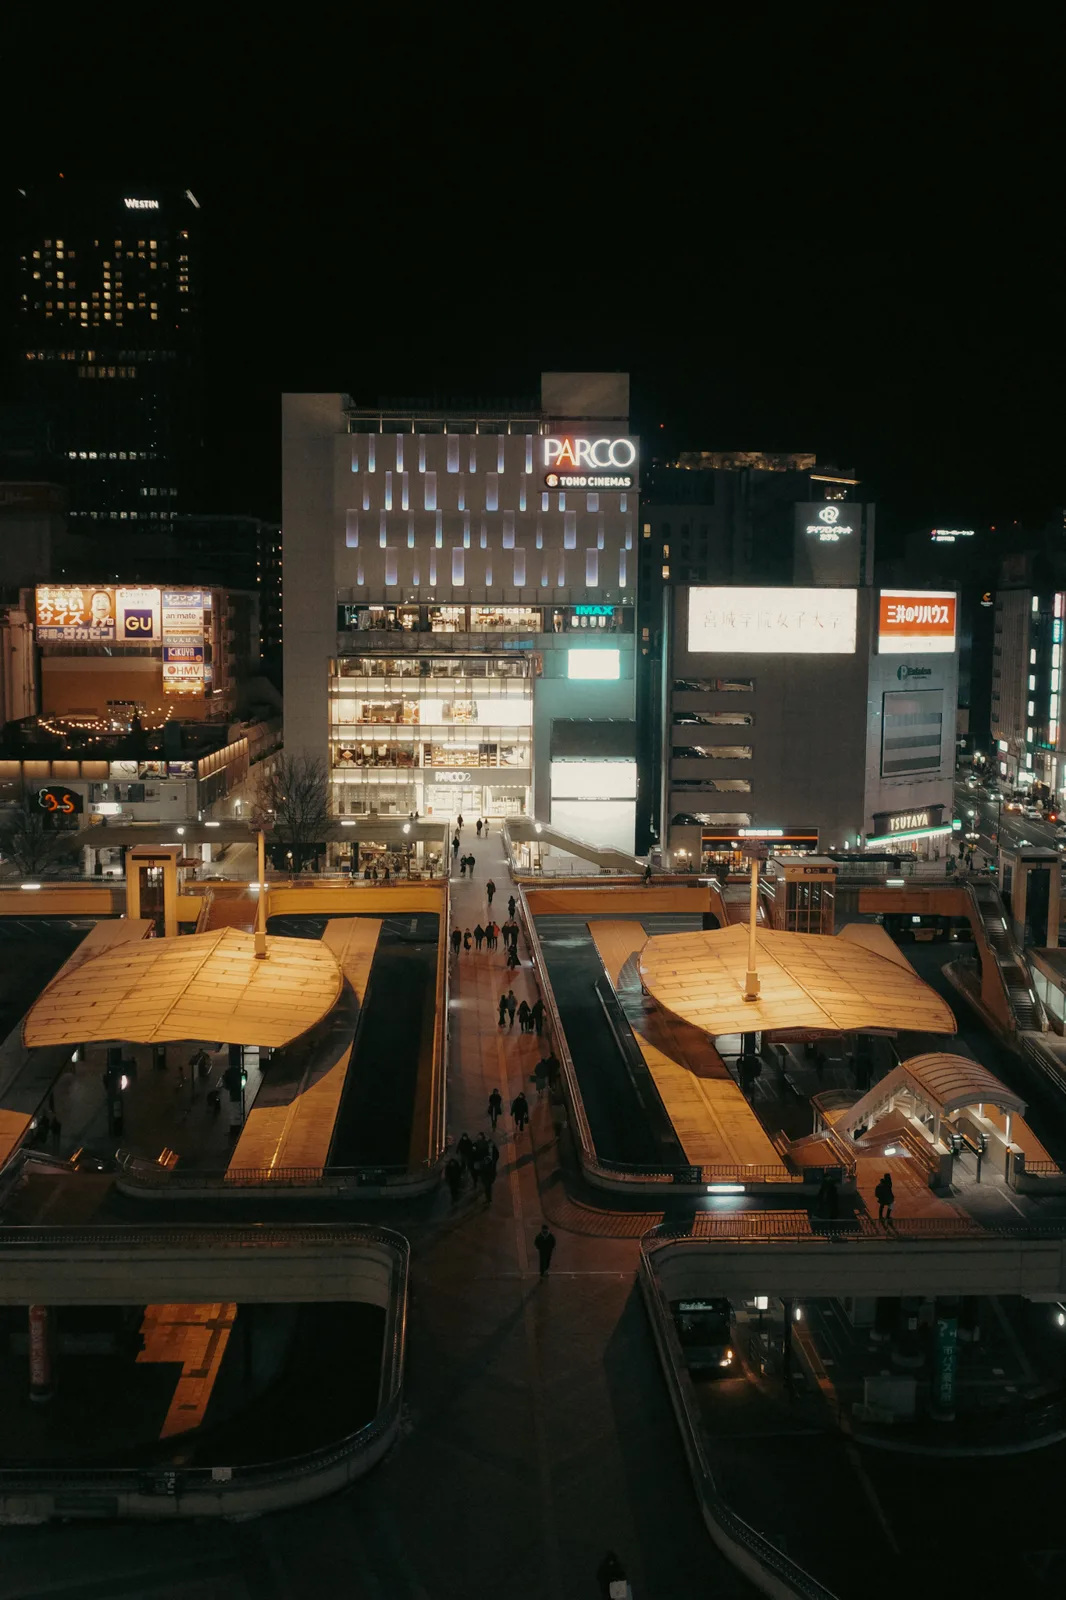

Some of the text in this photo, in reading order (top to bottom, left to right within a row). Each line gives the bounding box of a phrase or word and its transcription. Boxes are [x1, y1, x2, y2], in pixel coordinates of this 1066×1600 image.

[544, 438, 637, 468] PARCO
[560, 476, 631, 487] TOHO CINEMAS
[38, 597, 84, 611] 大きい
[575, 605, 614, 615] IMAX
[38, 610, 84, 625] サイズ
[165, 611, 197, 620] anmate
[702, 608, 844, 629] 宮城学院女子大学
[886, 604, 950, 624] 三井のリハウス
[125, 615, 152, 631] GU
[176, 666, 200, 675] HMV
[890, 813, 928, 831] TSUTAYA
